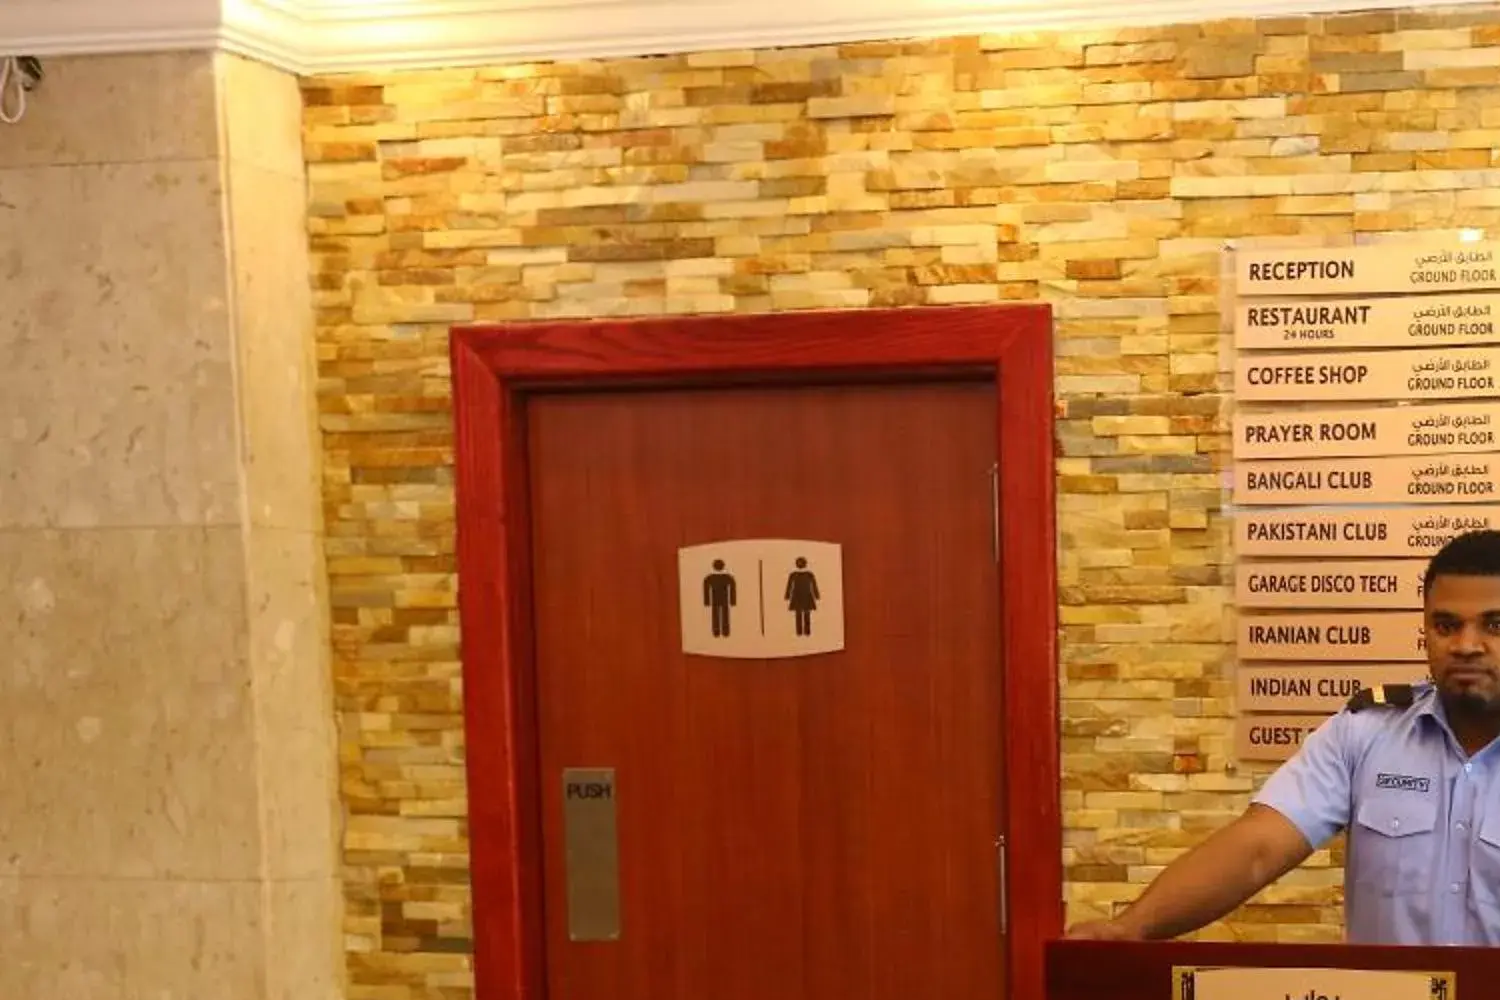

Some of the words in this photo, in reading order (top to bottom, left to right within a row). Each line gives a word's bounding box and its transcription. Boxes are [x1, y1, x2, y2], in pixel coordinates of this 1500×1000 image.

[1249, 260, 1354, 281] RECEPTION
[1409, 270, 1457, 284] GROUND
[1461, 268, 1496, 282] FLOOR
[1247, 306, 1371, 326] RESTAURANT
[1300, 329, 1334, 339] HOURS
[1408, 323, 1455, 336] GROUND
[1458, 322, 1493, 335] FLOOR
[1247, 367, 1315, 385] COFFEE
[1319, 365, 1368, 384] SHOP
[1408, 377, 1454, 391] GROUND
[1457, 376, 1495, 389] FLOOR
[1245, 424, 1313, 443] PRAYER
[1320, 422, 1376, 440] ROOM
[1408, 433, 1454, 446] GROUND
[1458, 431, 1494, 444] FLOOR
[1247, 471, 1321, 490] BANGALI
[1328, 471, 1372, 489] CLUB
[1408, 482, 1454, 494] GROUND
[1458, 481, 1493, 494] FLOOR
[1247, 523, 1337, 541] PAKISTANI
[1343, 523, 1387, 541] CLUB
[1248, 575, 1307, 593] GARAGE
[1311, 575, 1355, 593] DISCO
[1359, 575, 1397, 593] TECH
[1249, 626, 1320, 644] IRANIAN
[1326, 626, 1371, 644] CLUB
[1251, 679, 1311, 696] INDIAN
[1317, 679, 1361, 697] CLUB
[1249, 727, 1303, 745] GUEST
[567, 783, 611, 799] PUSH
